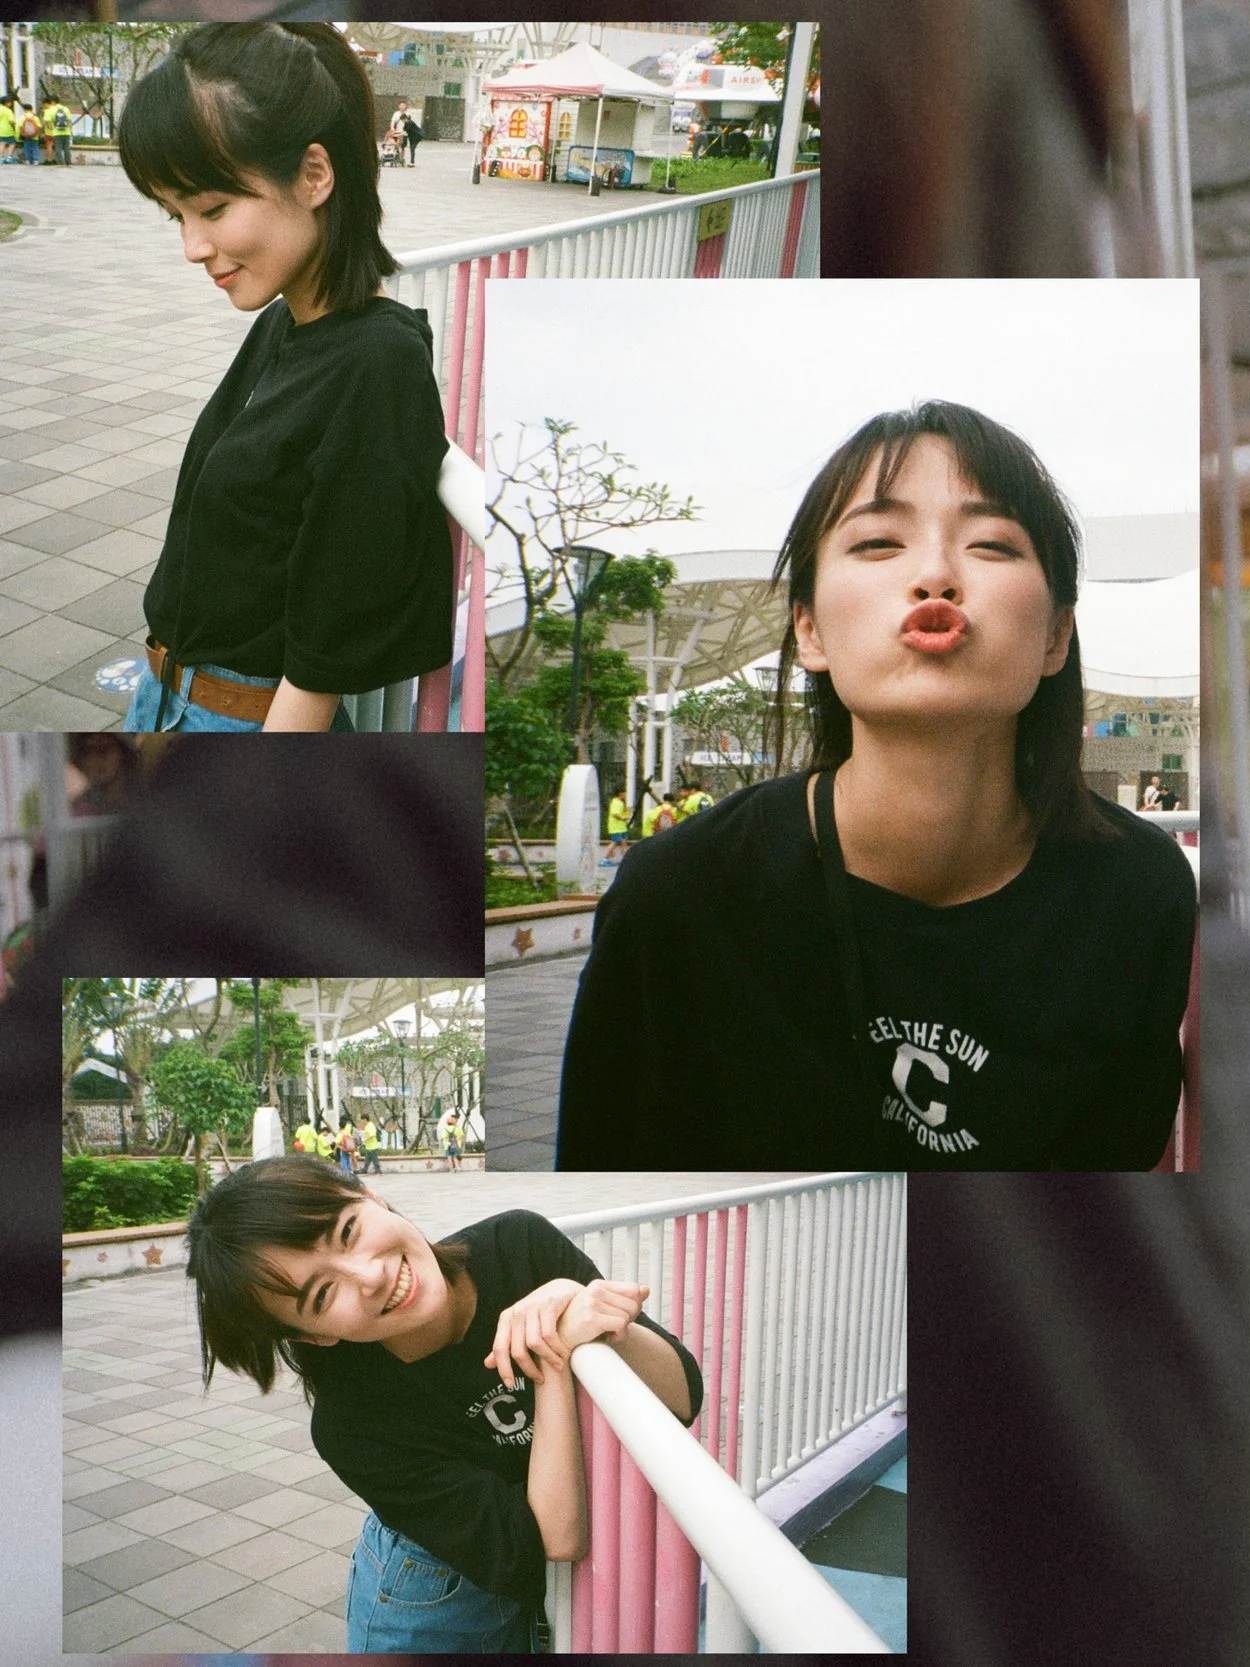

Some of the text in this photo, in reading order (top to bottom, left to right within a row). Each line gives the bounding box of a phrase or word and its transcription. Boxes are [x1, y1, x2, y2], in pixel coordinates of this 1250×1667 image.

[900, 1020, 944, 1051] THE
[945, 1028, 990, 1073] SUN
[891, 1042, 950, 1128] C
[882, 1095, 980, 1153] CALIFORNIA
[482, 1383, 505, 1401] THE
[483, 1394, 527, 1435] C
